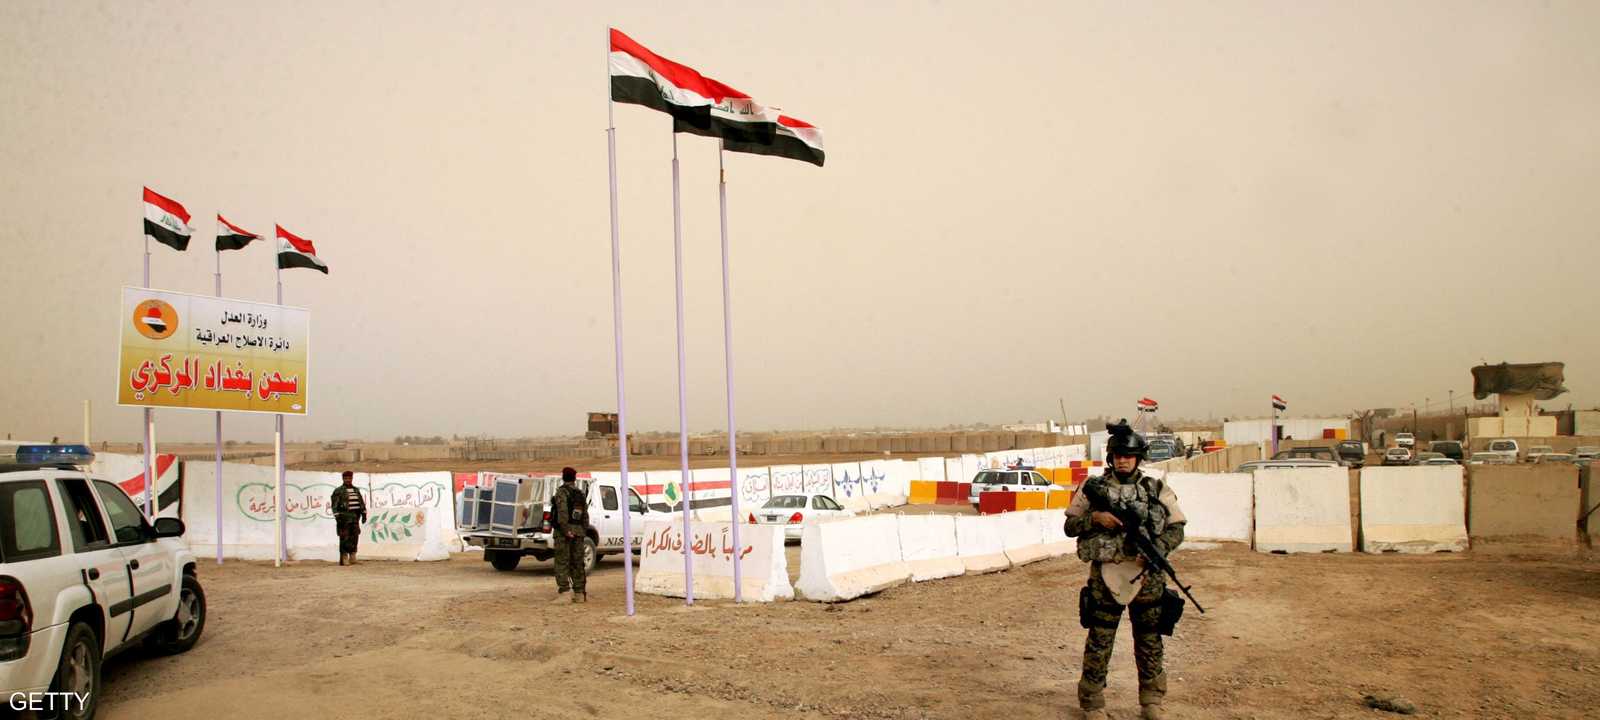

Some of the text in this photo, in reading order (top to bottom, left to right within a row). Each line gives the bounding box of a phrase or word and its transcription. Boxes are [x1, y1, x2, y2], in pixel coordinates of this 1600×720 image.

[221, 311, 268, 329] وزارة العدل
[196, 328, 233, 346] العراقية
[235, 334, 267, 348] الاصلاح
[130, 353, 298, 401] سجن بغداد المركزي
[645, 526, 672, 558] الكرام
[721, 526, 753, 561] مرباً
